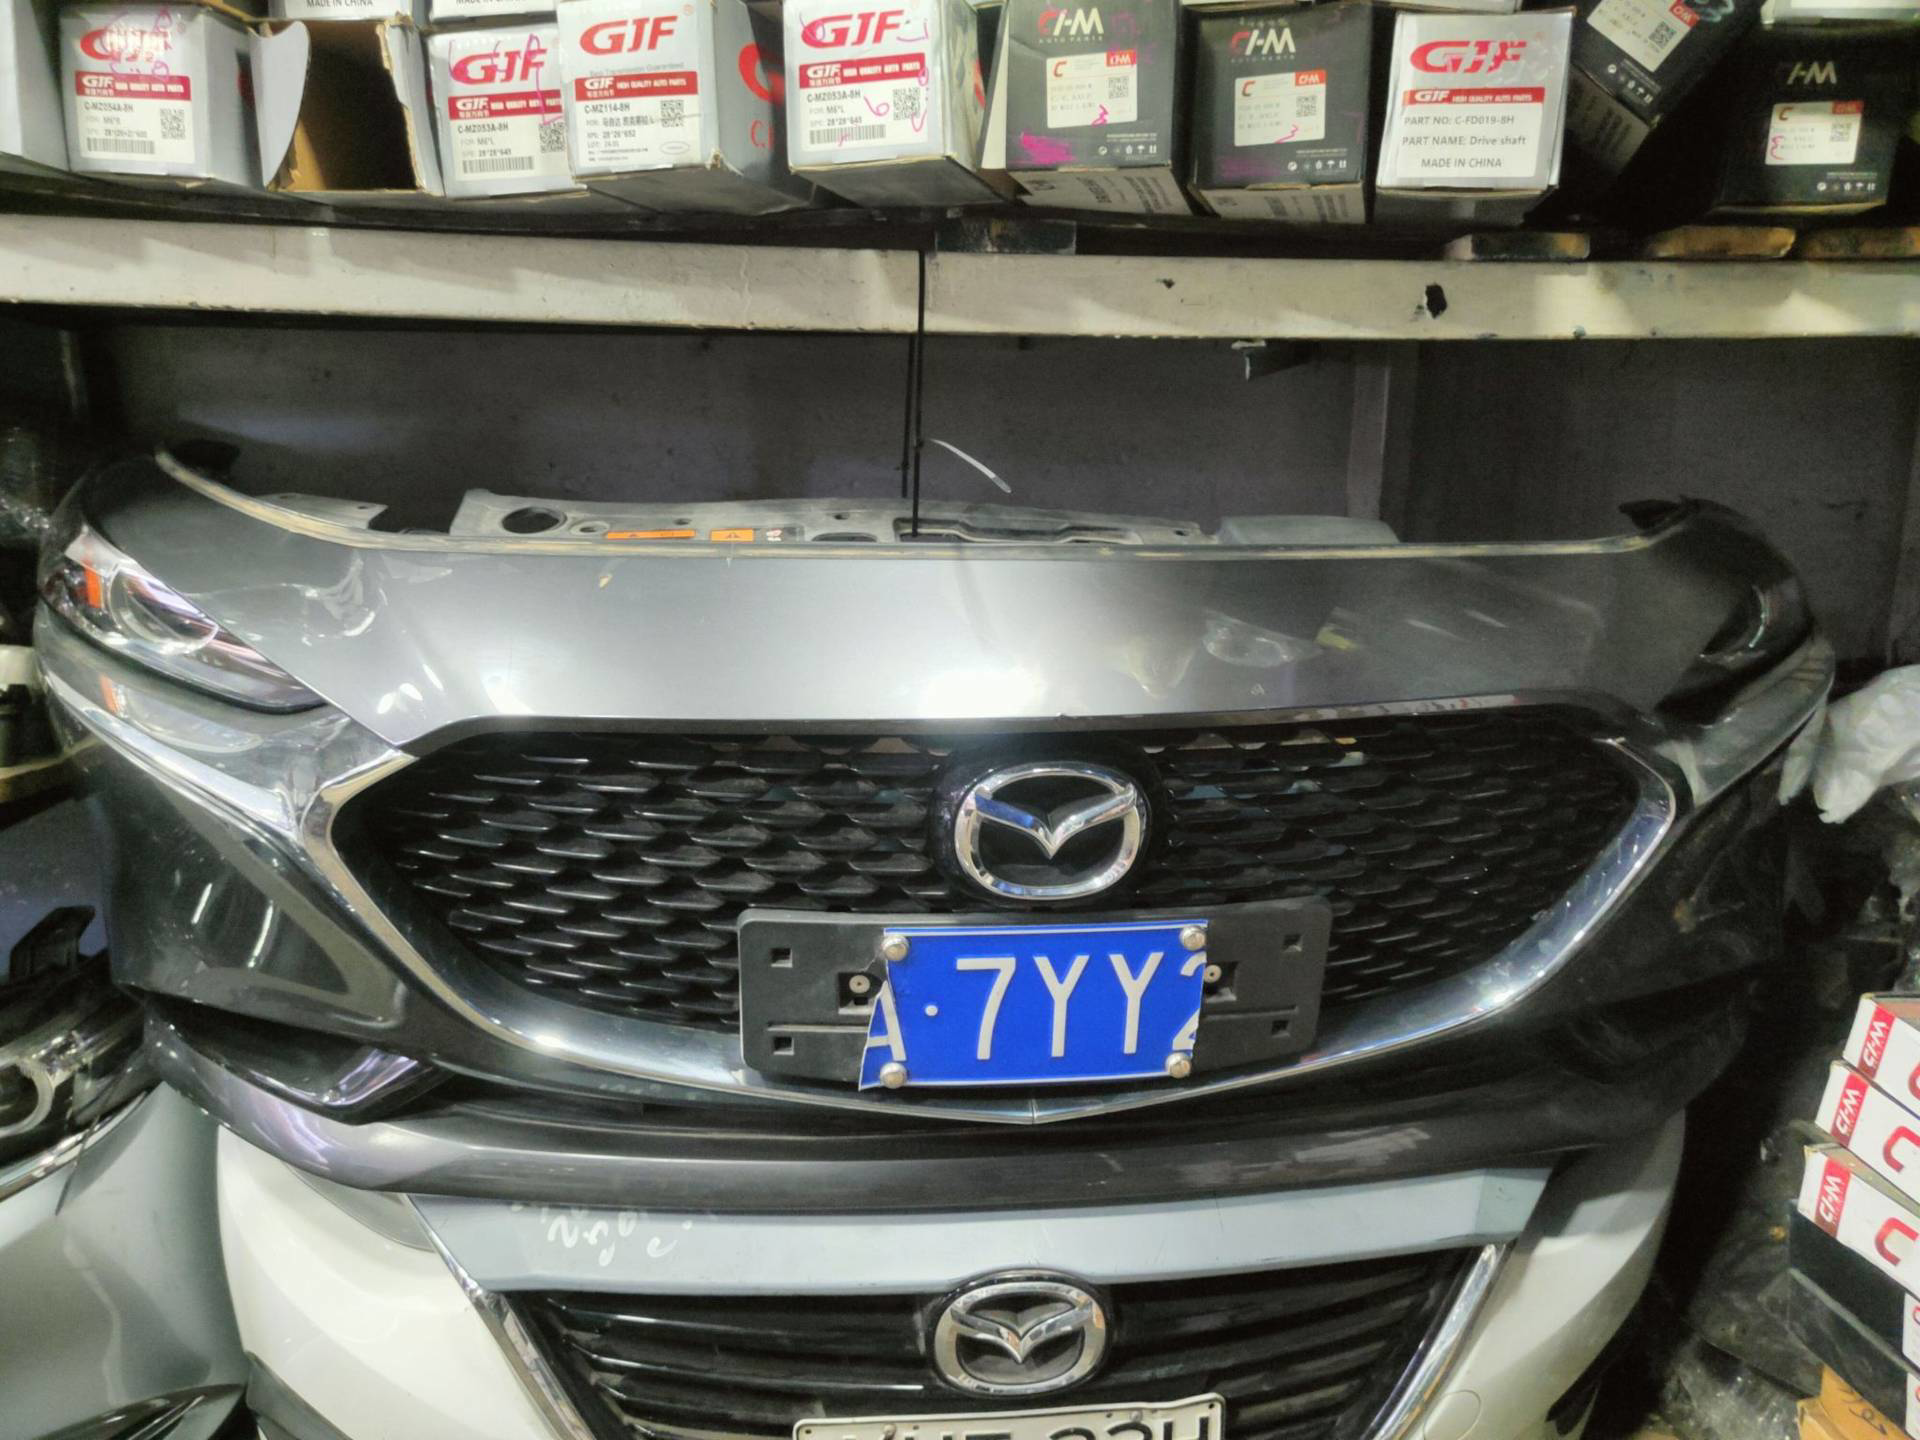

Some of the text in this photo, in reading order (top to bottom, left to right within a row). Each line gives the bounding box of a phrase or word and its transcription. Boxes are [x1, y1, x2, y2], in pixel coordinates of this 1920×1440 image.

[579, 15, 678, 56] GJF
[801, 9, 904, 49] GJF
[452, 48, 548, 85] GJF
[1404, 115, 1514, 125] PART NO: C-FD019-8H
[1402, 135, 1526, 146] PART NAME: Drive shaft
[1421, 158, 1502, 168] MADE IN CHINA
